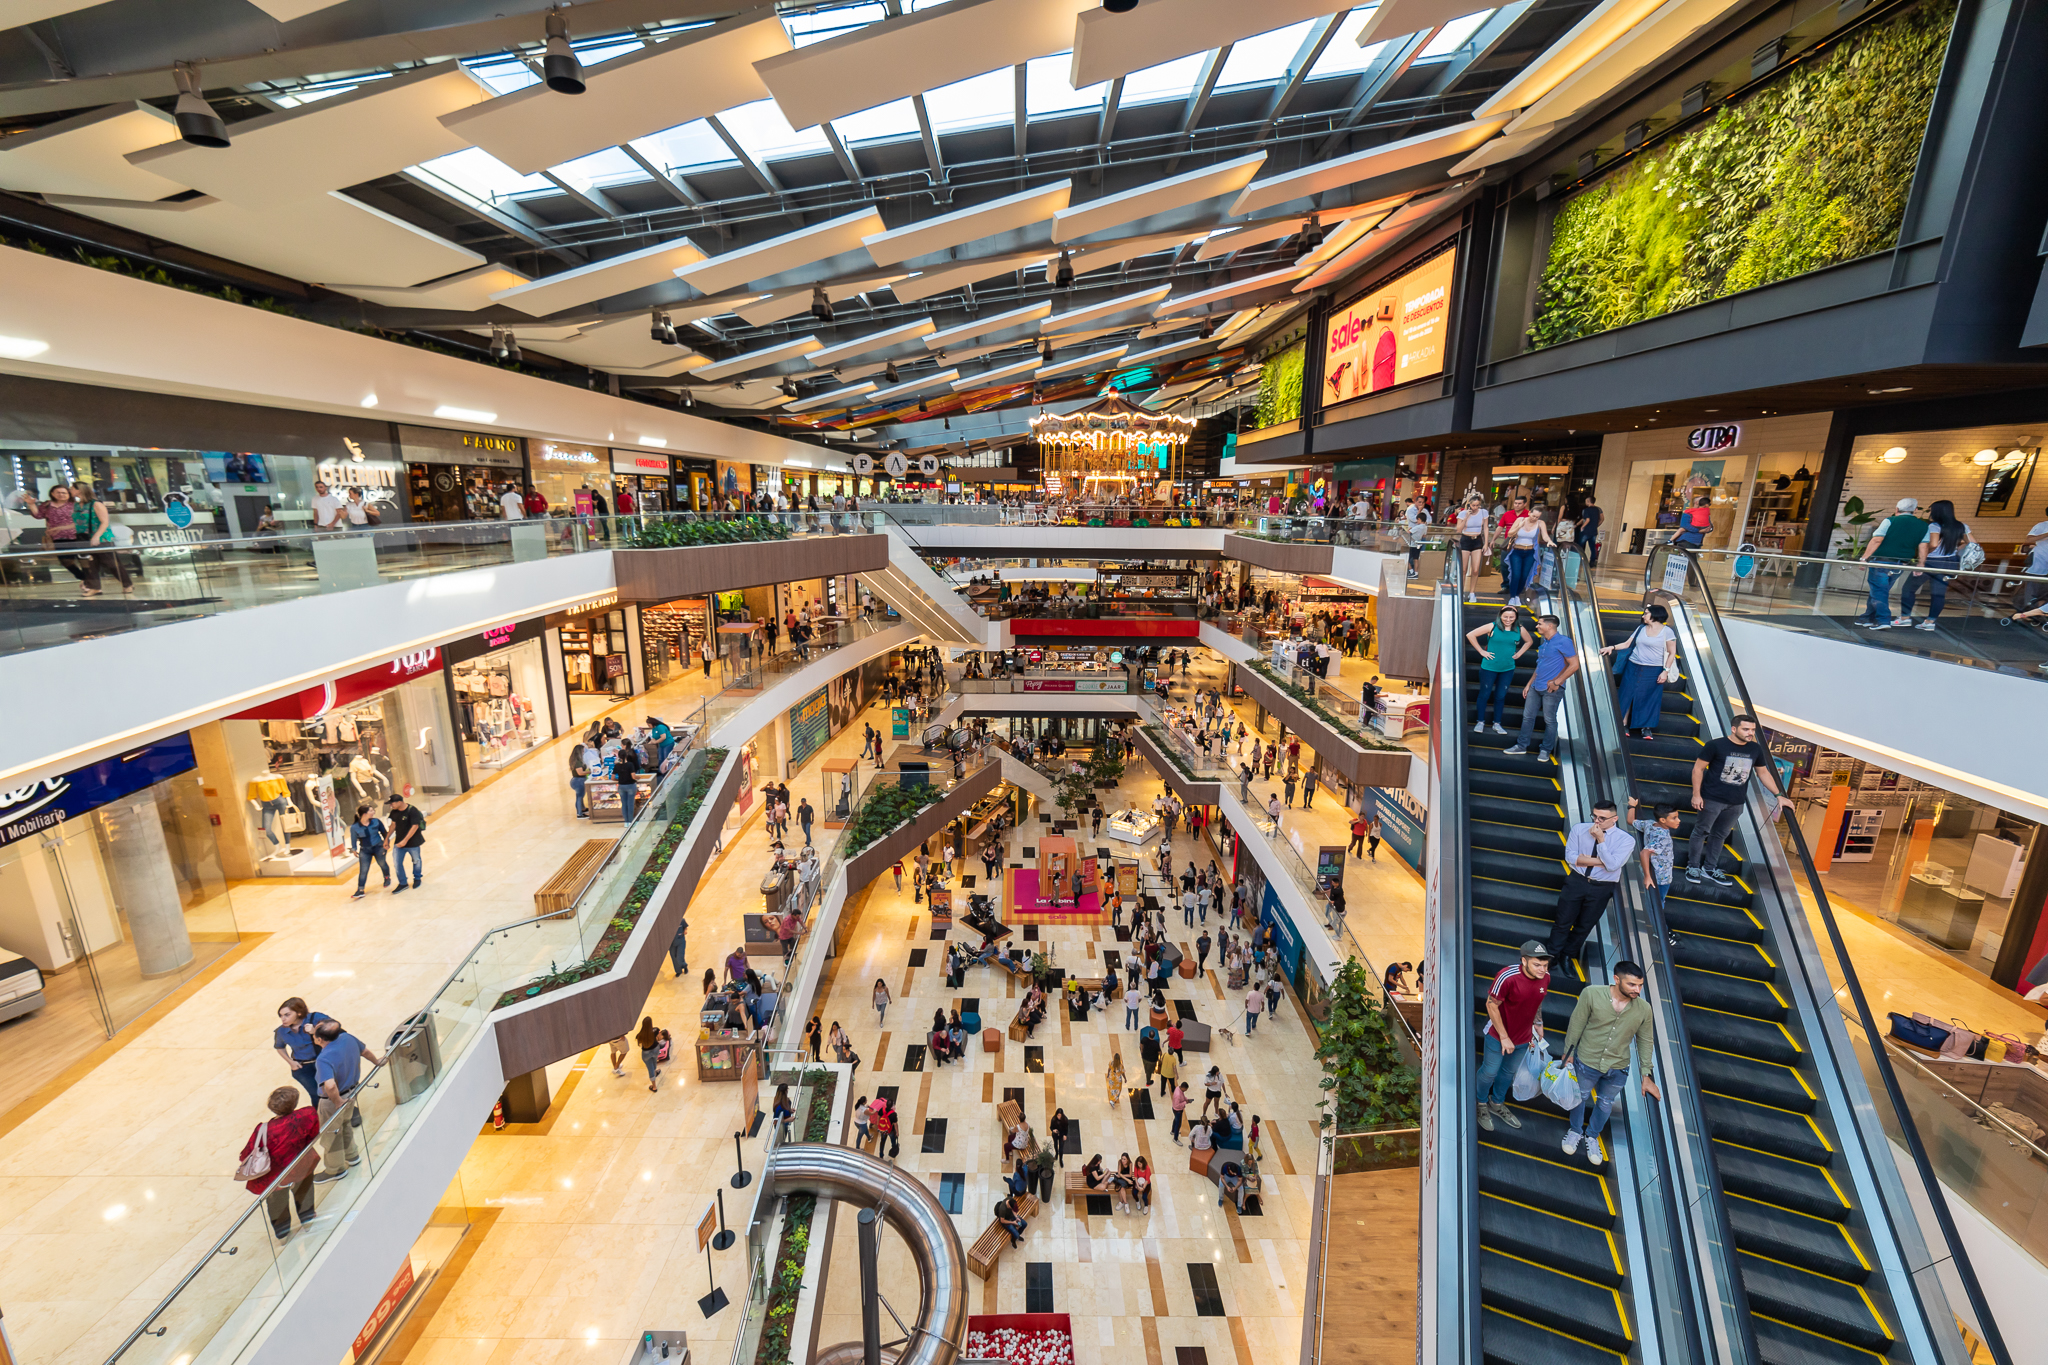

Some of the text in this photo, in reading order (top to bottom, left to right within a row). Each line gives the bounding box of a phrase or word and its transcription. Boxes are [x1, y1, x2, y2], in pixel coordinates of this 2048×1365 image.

[1404, 285, 1445, 313] TEMPORADA
[1403, 299, 1444, 325] DE DESCUENTOS
[1331, 311, 1360, 353] sale
[1408, 345, 1435, 361] ARKADIA
[463, 434, 516, 453] FAUNO
[1687, 425, 1738, 449] ESTRA
[319, 464, 396, 487] CELEBRITY
[137, 529, 203, 546] CELEBRITY
[7, 809, 66, 840] Mobiliario
[1384, 804, 1392, 818] PARA
[1395, 816, 1411, 834] DEPORTE
[1392, 822, 1400, 836] PARA
[1400, 829, 1413, 846] TODOS
[1318, 864, 1340, 874] sale
